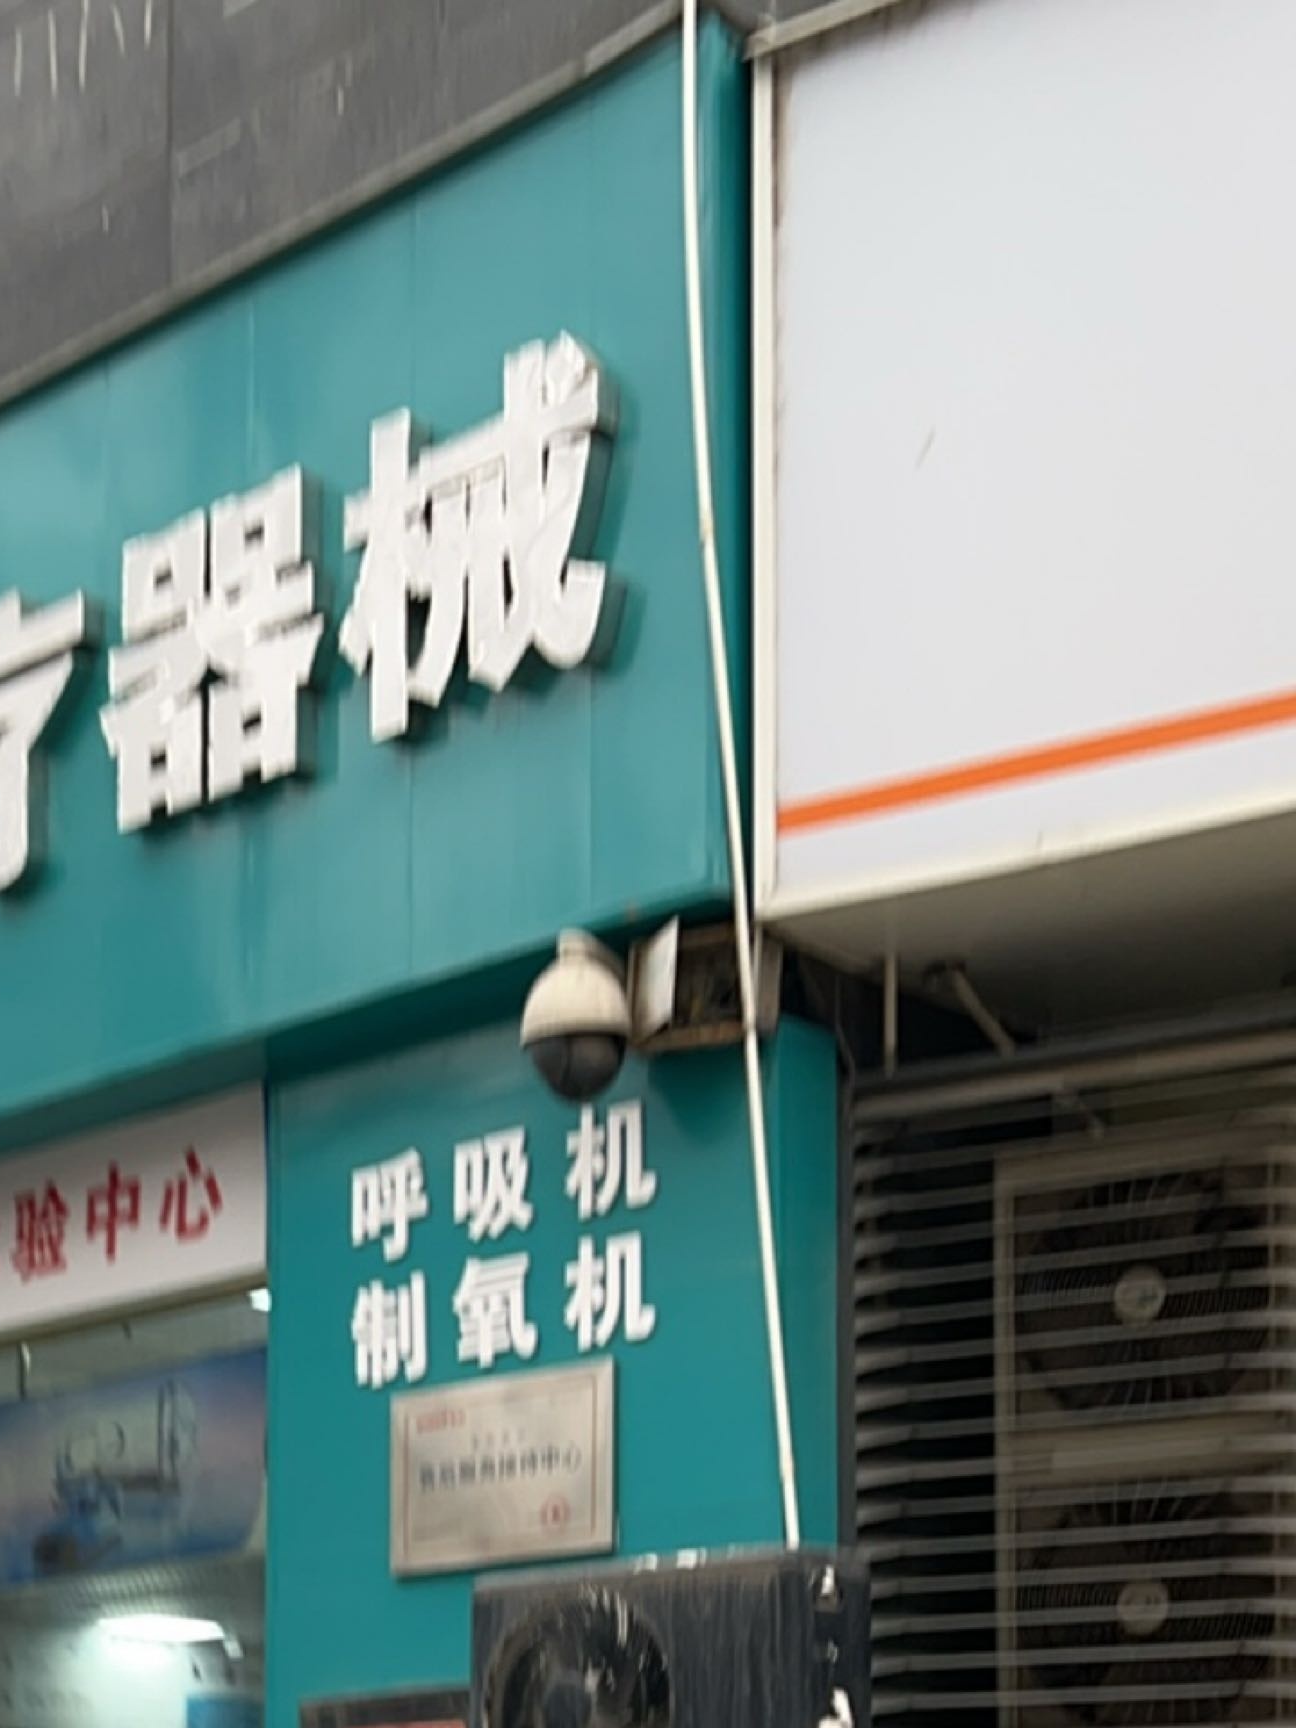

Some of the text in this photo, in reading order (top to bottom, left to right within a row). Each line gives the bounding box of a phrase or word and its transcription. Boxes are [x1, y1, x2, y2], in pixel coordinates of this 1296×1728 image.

[352, 1099, 657, 1262] 呼吸机
[352, 1231, 656, 1389] 制氧机
